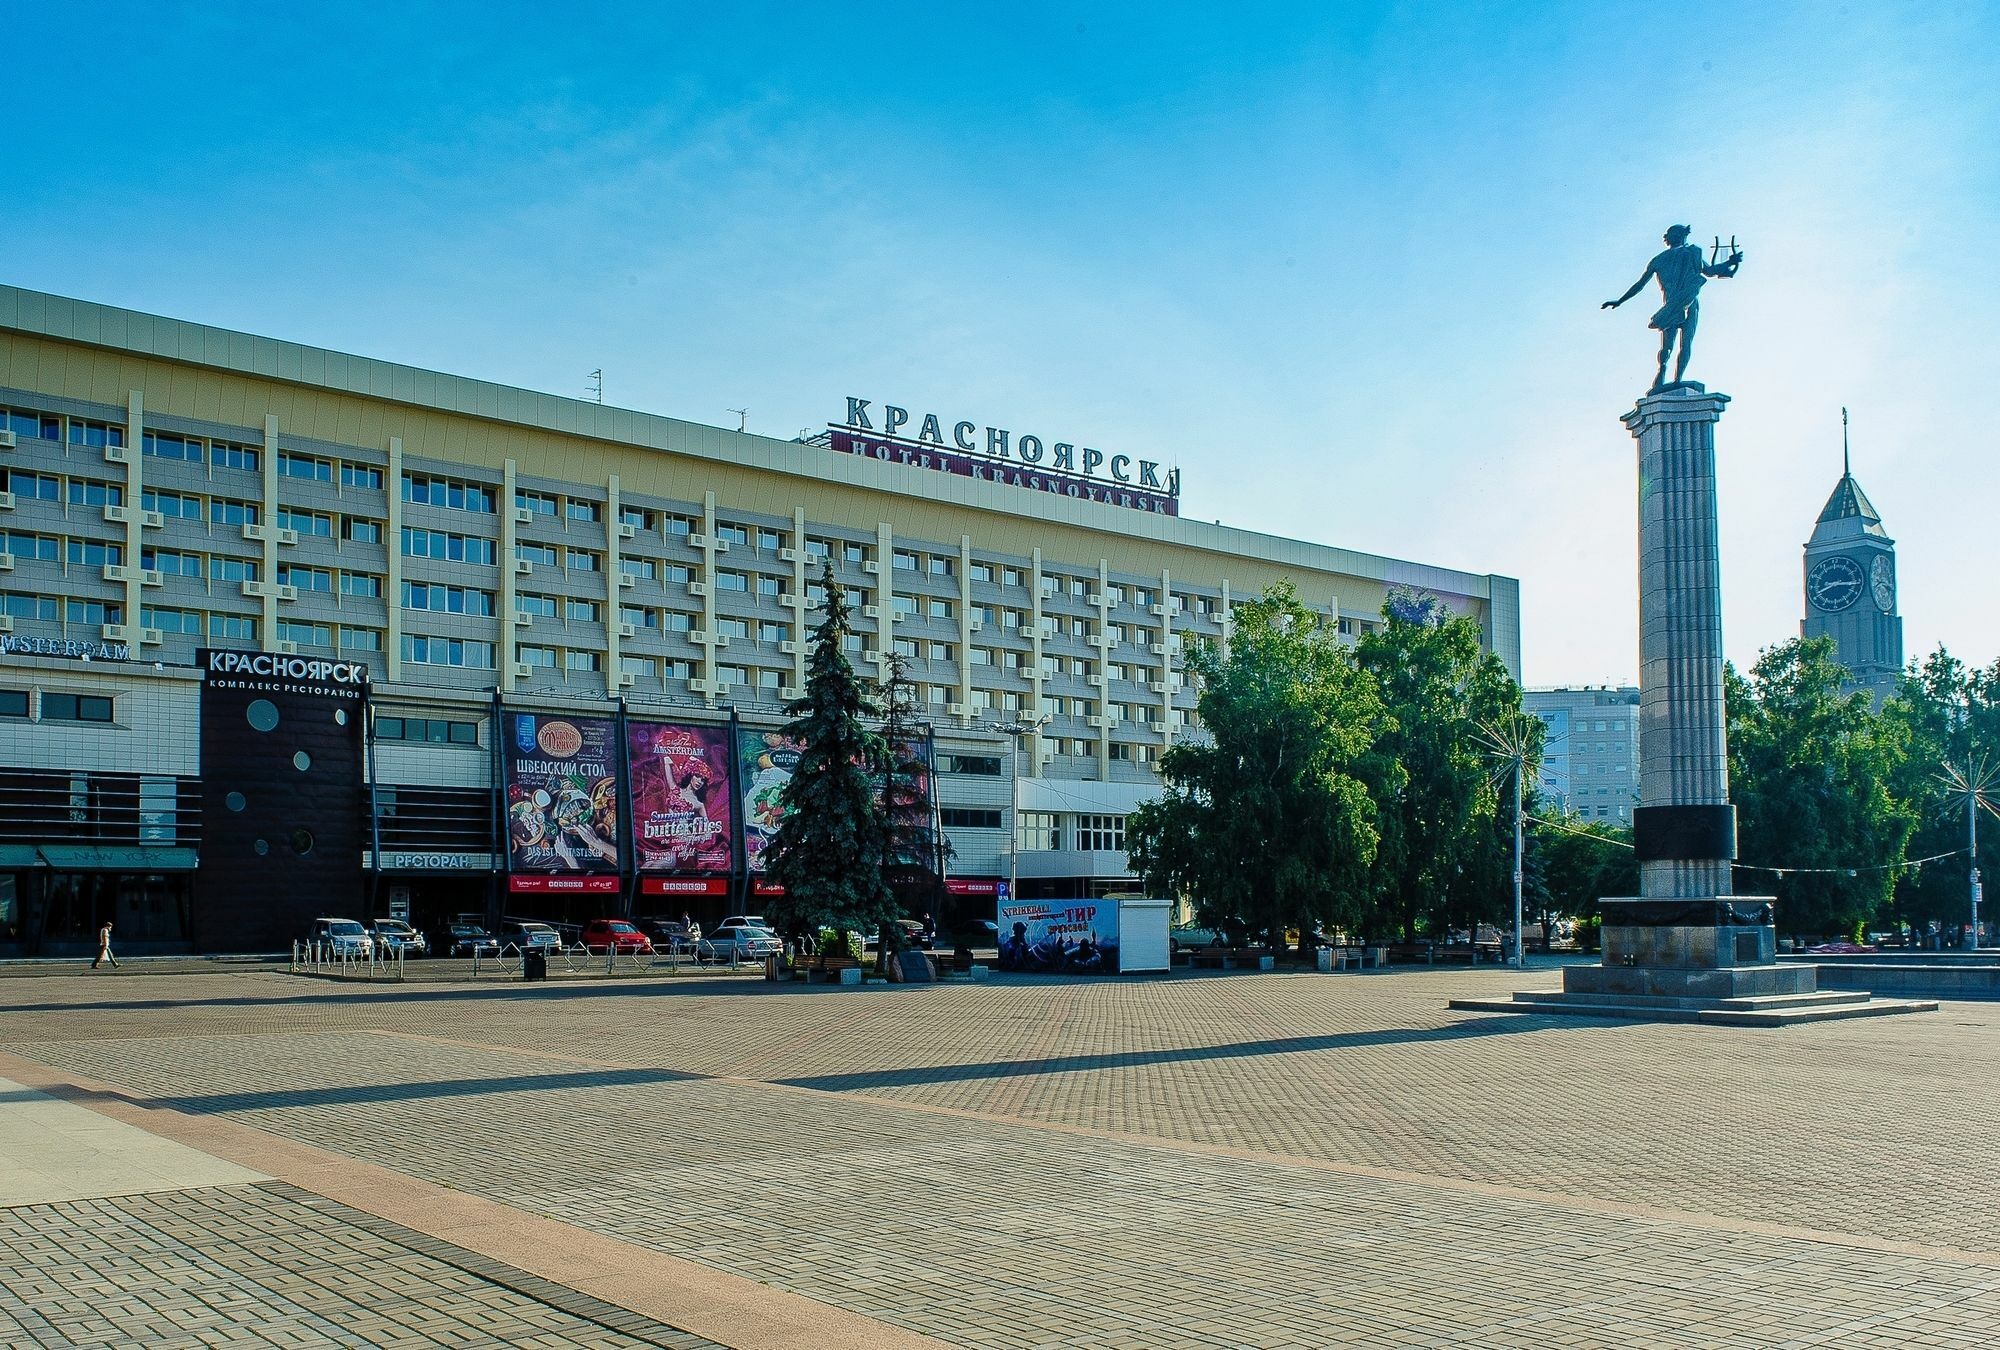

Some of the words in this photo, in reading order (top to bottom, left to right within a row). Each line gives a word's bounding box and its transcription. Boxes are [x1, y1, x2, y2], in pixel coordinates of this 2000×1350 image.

[845, 396, 1160, 488] КРАСНОЯРСК
[851, 440, 951, 474] HOTEL
[971, 464, 1166, 515] KRASNOYARSK
[209, 652, 363, 684] КРАСНОЯРСК
[210, 680, 280, 691] КОМПЛЕКС
[284, 684, 360, 699] РЕСТОРАНОВ
[653, 743, 704, 756] AMSTERDAM
[516, 759, 577, 776] ШВЕДСКИЙ
[580, 763, 606, 777] СТОЛ
[650, 811, 695, 823] Summer
[644, 816, 722, 838] butterflies
[122, 852, 164, 862] YORK
[395, 855, 469, 868] РЕСТОРАН
[662, 882, 707, 891] BANGKOK
[1002, 904, 1051, 918] STRIKEBALL
[1065, 906, 1097, 922] ТИР
